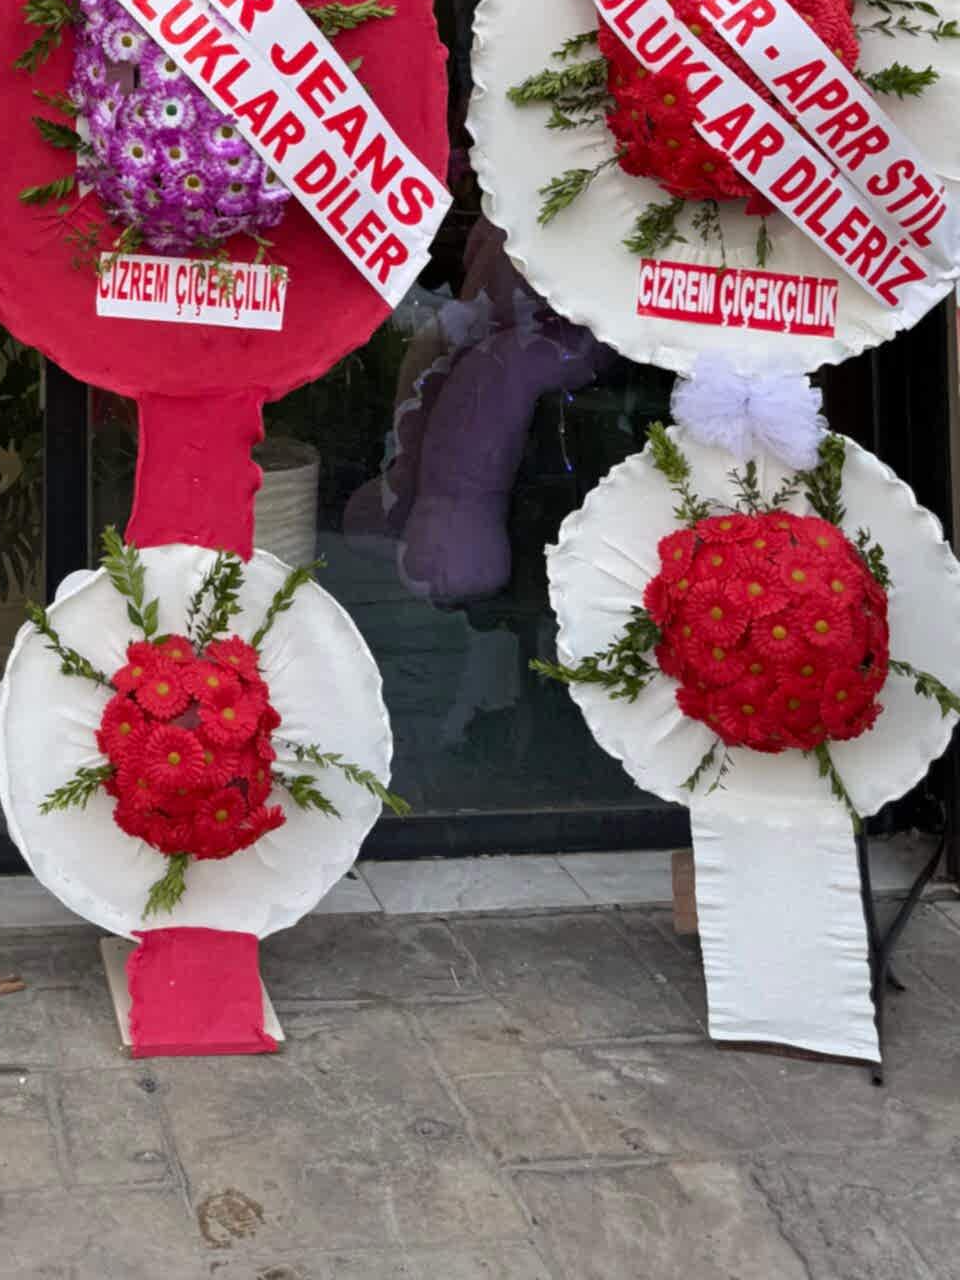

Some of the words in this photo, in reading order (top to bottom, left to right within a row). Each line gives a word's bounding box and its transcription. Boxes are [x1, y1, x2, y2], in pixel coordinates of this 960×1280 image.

[270, 40, 435, 226] JEANS
[772, 58, 890, 172] APRR
[866, 159, 947, 248] STİL
[293, 149, 409, 284] DİLER
[769, 155, 927, 307] DİLERİZ
[640, 261, 716, 314] CİZREM
[720, 270, 837, 333] ÇİÇEKÇİLİK
